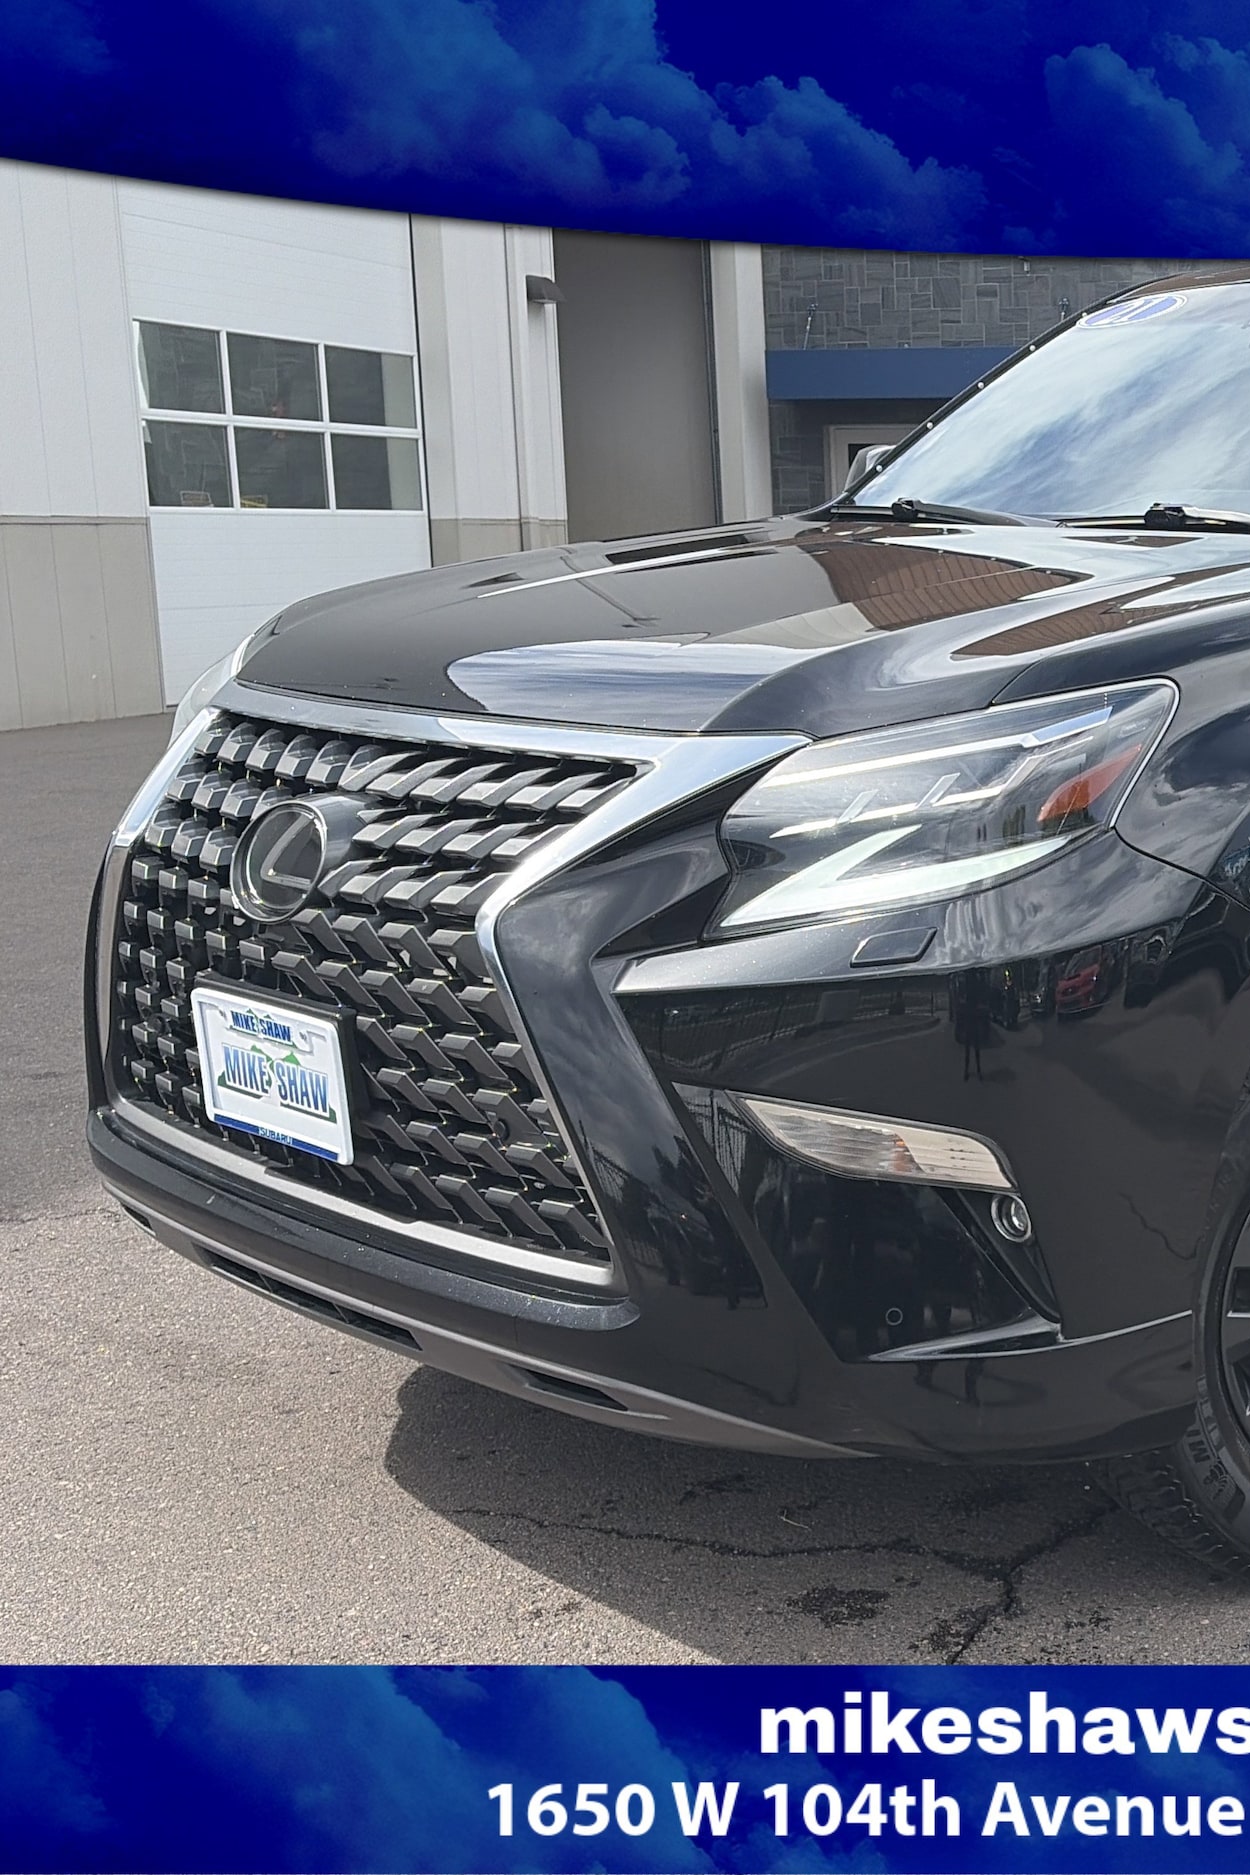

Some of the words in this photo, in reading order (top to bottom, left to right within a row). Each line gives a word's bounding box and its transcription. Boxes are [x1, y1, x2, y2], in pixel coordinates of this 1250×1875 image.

[231, 1011, 257, 1033] MIKE
[260, 1019, 291, 1042] SHAW
[223, 1045, 268, 1094] MIKE
[276, 1062, 328, 1113] SHAW
[260, 1126, 291, 1145] SUBARU
